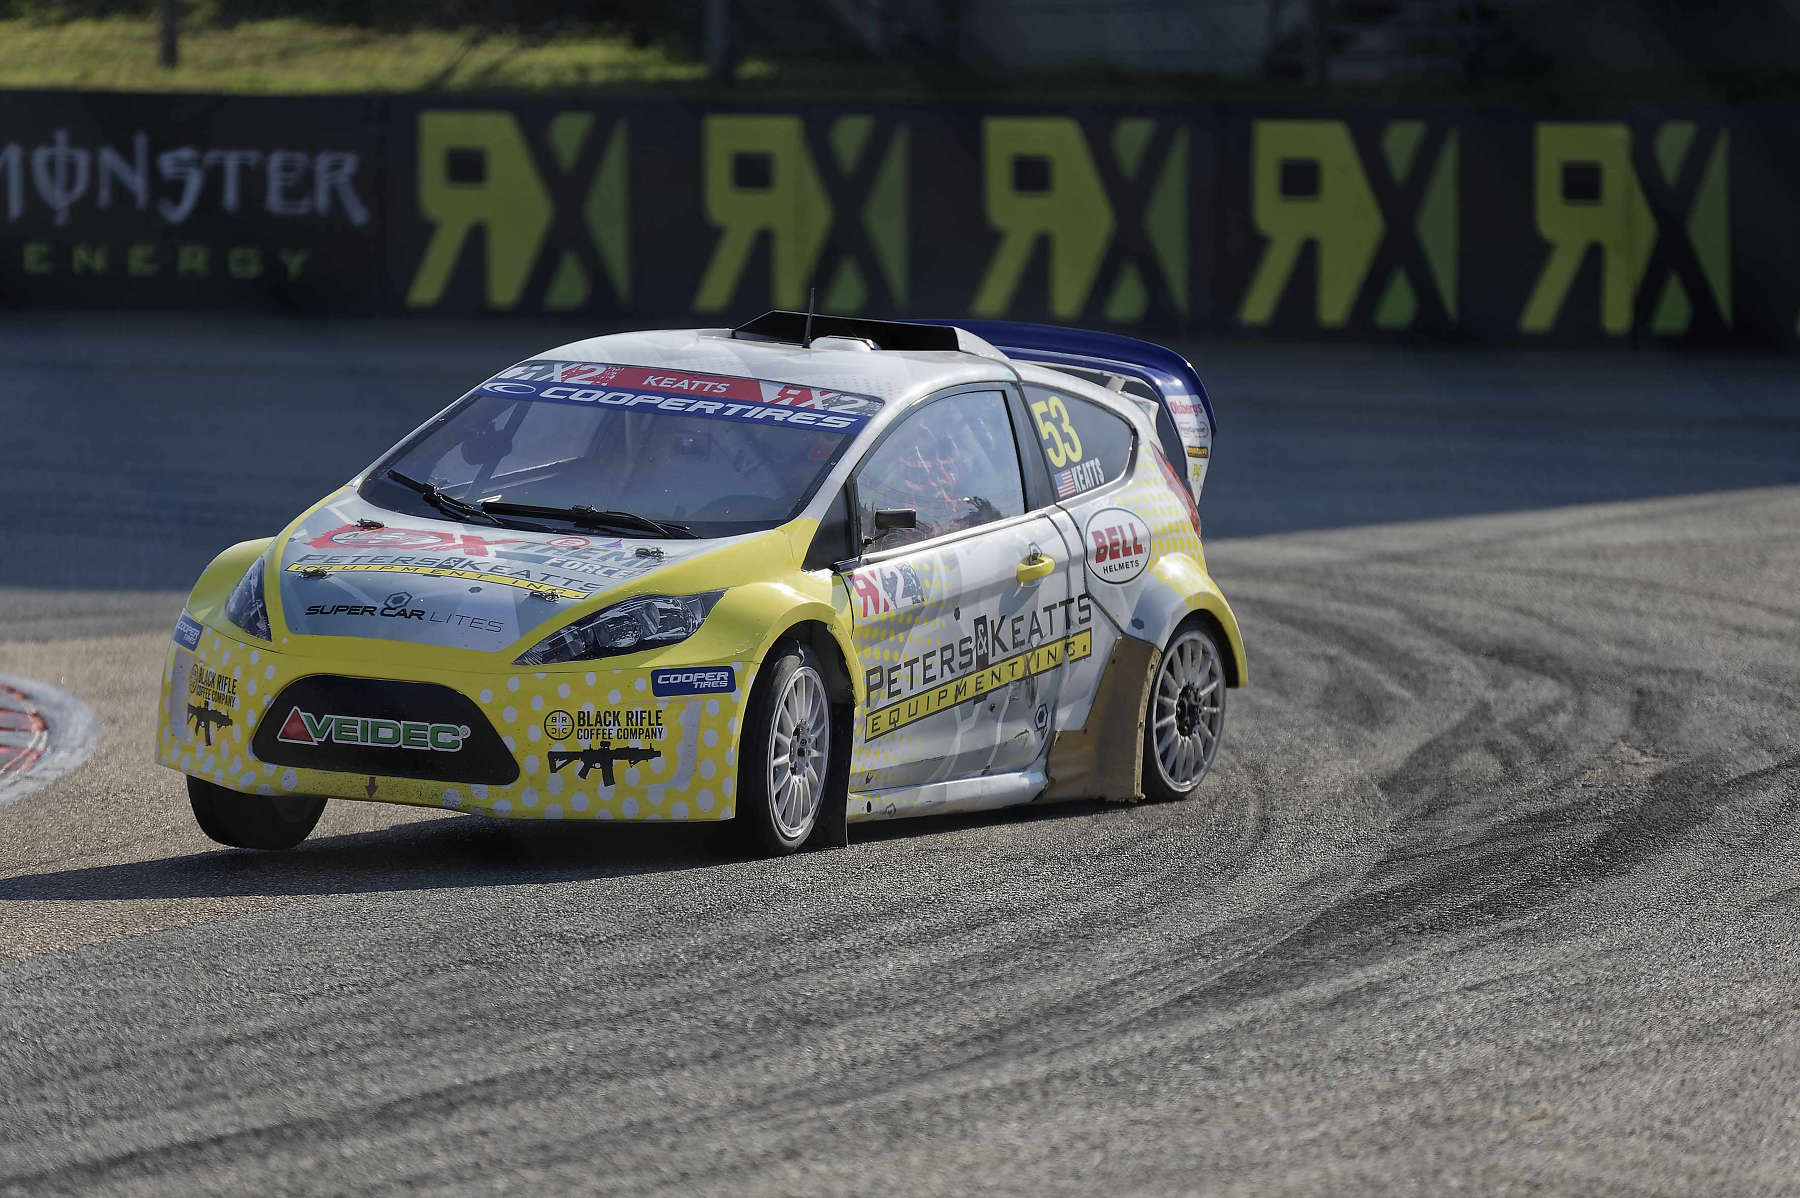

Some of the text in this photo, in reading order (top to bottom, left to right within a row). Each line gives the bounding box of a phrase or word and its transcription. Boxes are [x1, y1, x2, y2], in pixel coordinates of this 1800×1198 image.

[23, 243, 310, 278] ENERGY
[642, 375, 731, 394] KEATTS
[1031, 396, 1083, 468] 53
[1071, 457, 1105, 494] KEATTS
[1091, 522, 1144, 564] BELL
[1102, 559, 1140, 575] HELMETS
[177, 620, 200, 638] COOPER
[429, 611, 504, 633] LITES
[198, 666, 216, 687] BLACK
[217, 674, 238, 695] RIFLE
[657, 671, 729, 685] COOPER
[693, 680, 728, 689] TIRES
[211, 690, 237, 708] COMPANY
[870, 661, 1018, 733] EQUIPMENT
[577, 710, 664, 727] BLACK RIFLE
[576, 727, 664, 740] COFFEE COMPANY
